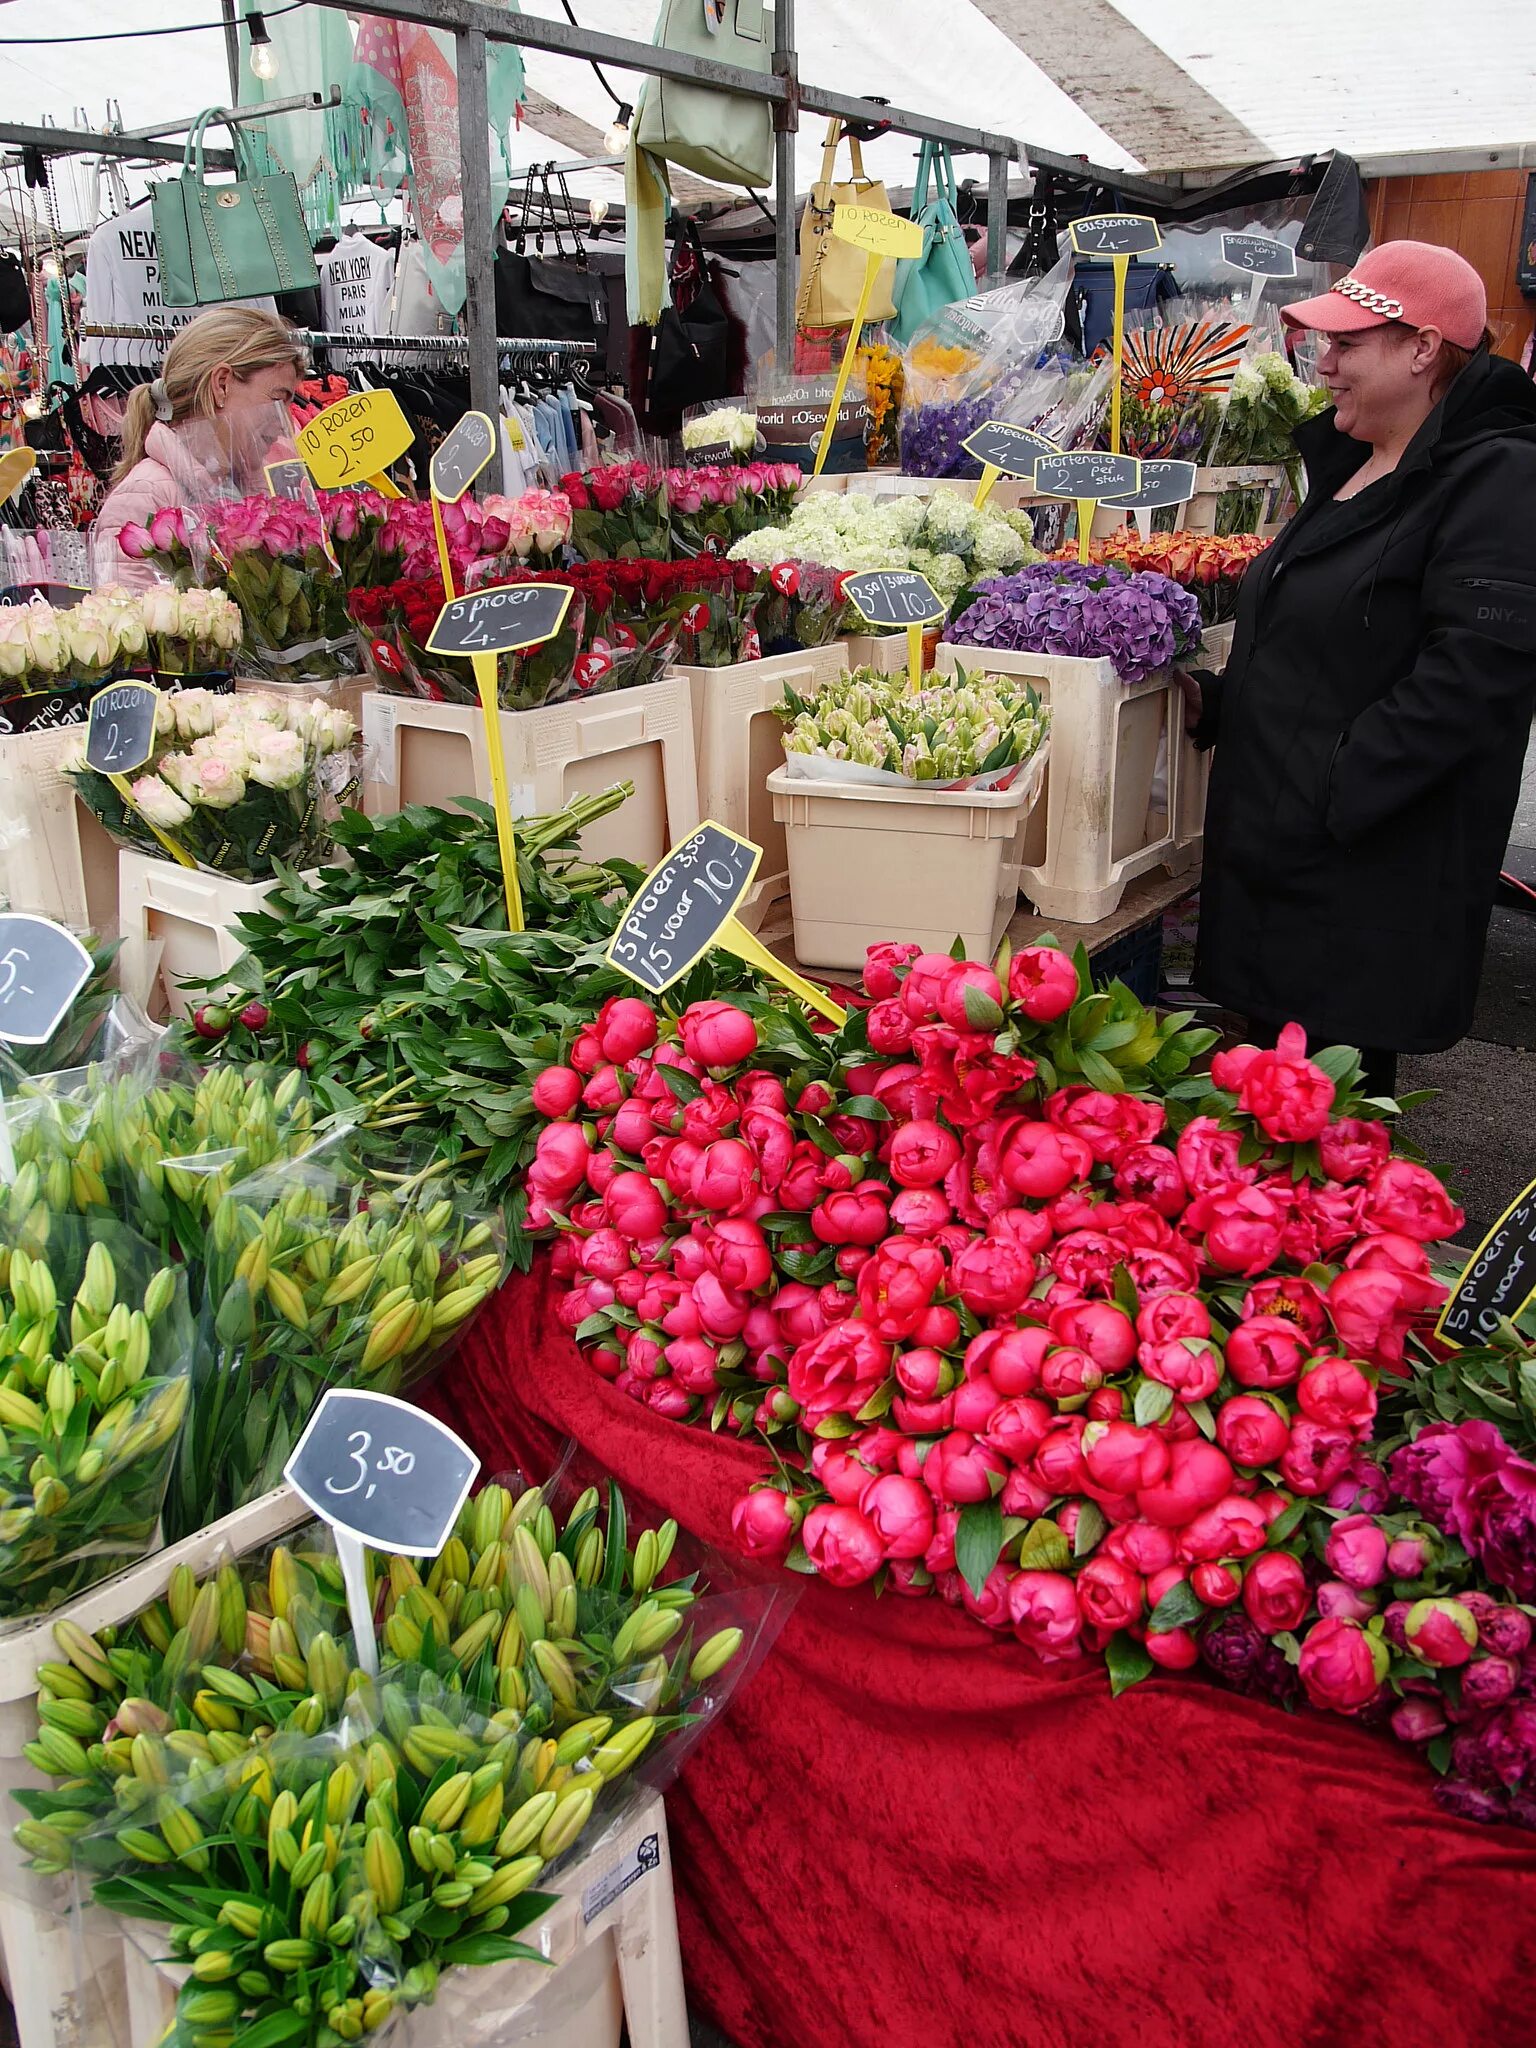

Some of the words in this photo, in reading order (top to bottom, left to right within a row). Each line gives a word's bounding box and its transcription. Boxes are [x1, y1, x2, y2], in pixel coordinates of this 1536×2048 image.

[841, 208, 857, 219] 10
[329, 261, 347, 283] NEW
[348, 256, 371, 279] YORK
[341, 284, 366, 301] PARIS
[339, 305, 366, 320] MILAN
[302, 430, 321, 455] 10
[1042, 454, 1116, 471] Hortencia
[1091, 464, 1115, 477] per
[1095, 474, 1125, 485] stuk
[451, 602, 466, 620] 5
[469, 589, 539, 623] pioen
[95, 695, 108, 720] 10
[255, 821, 278, 856] EQUINOX
[615, 938, 638, 961] 5
[674, 833, 706, 868] 3,50
[640, 941, 673, 985] 15
[693, 842, 743, 905] 10,-
[1444, 1306, 1470, 1330] 5
[1460, 1230, 1510, 1303] pioen
[1491, 1245, 1525, 1303] voor
[324, 1430, 416, 1499] 3,50
